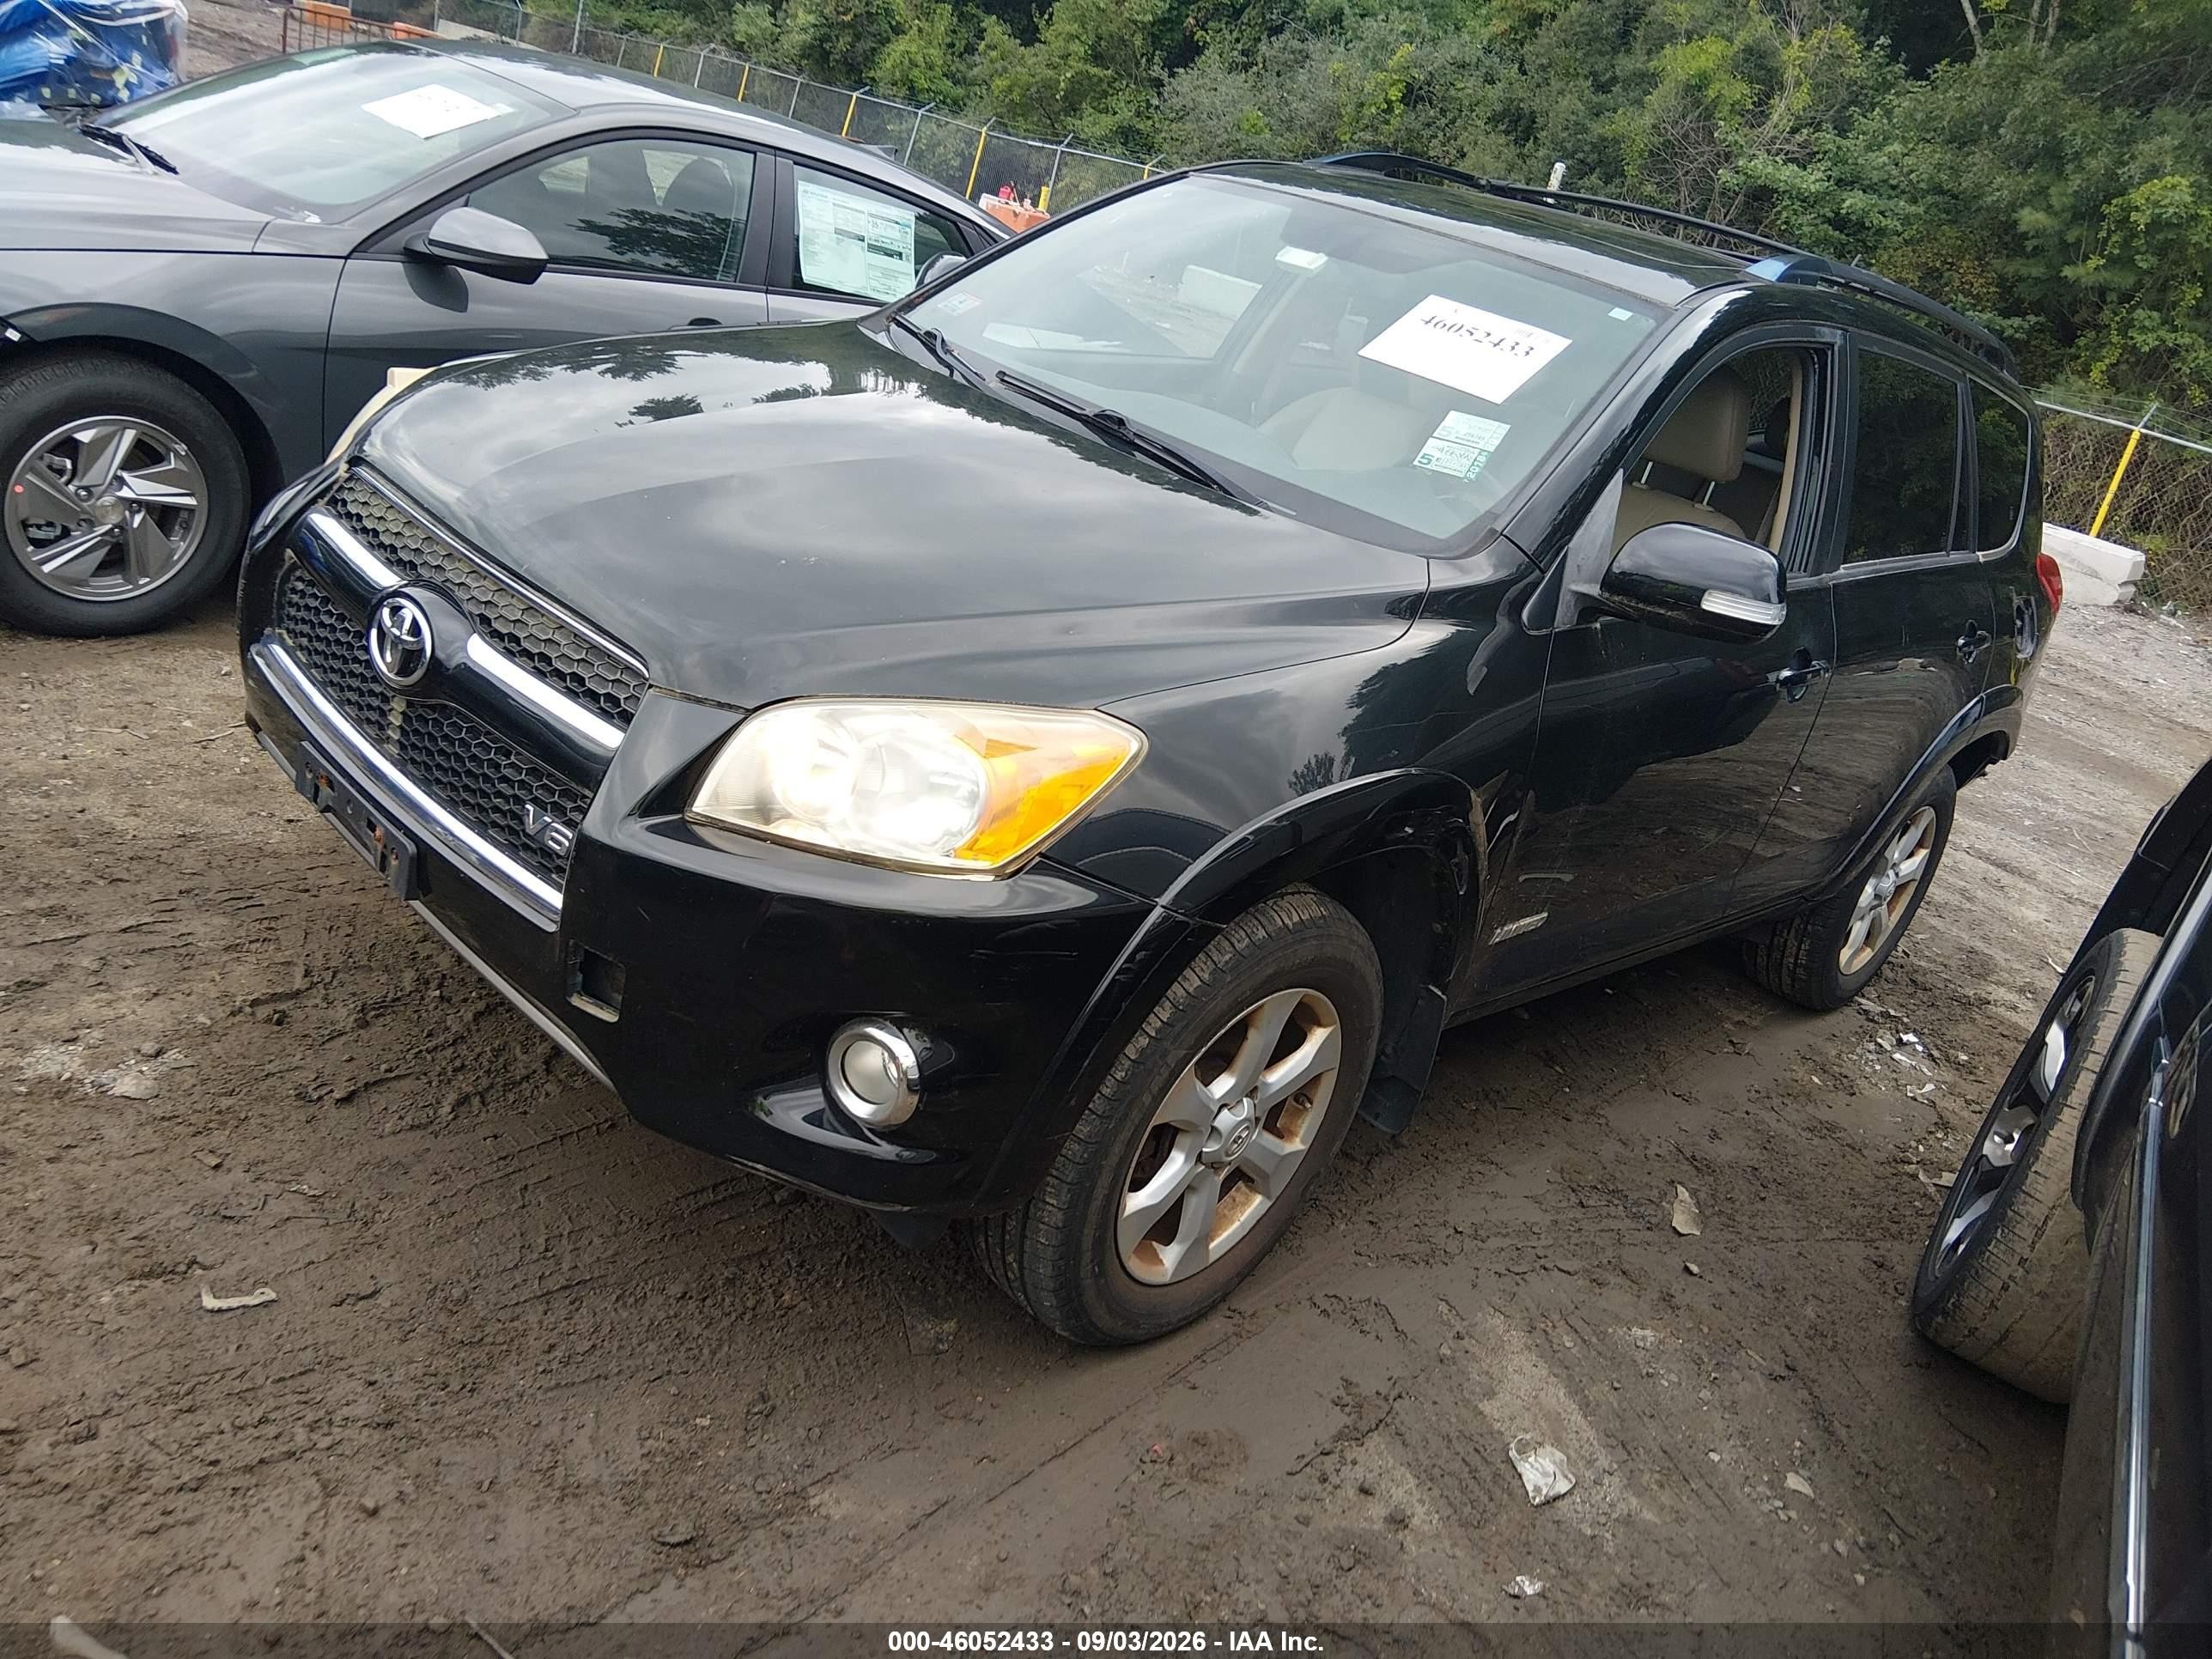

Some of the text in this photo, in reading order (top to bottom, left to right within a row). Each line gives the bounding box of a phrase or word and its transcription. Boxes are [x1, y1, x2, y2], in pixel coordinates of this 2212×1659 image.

[1420, 315, 1534, 357] 46052433
[1418, 453, 1435, 465] 5
[1467, 453, 1487, 478] 2018
[524, 801, 574, 856] V6
